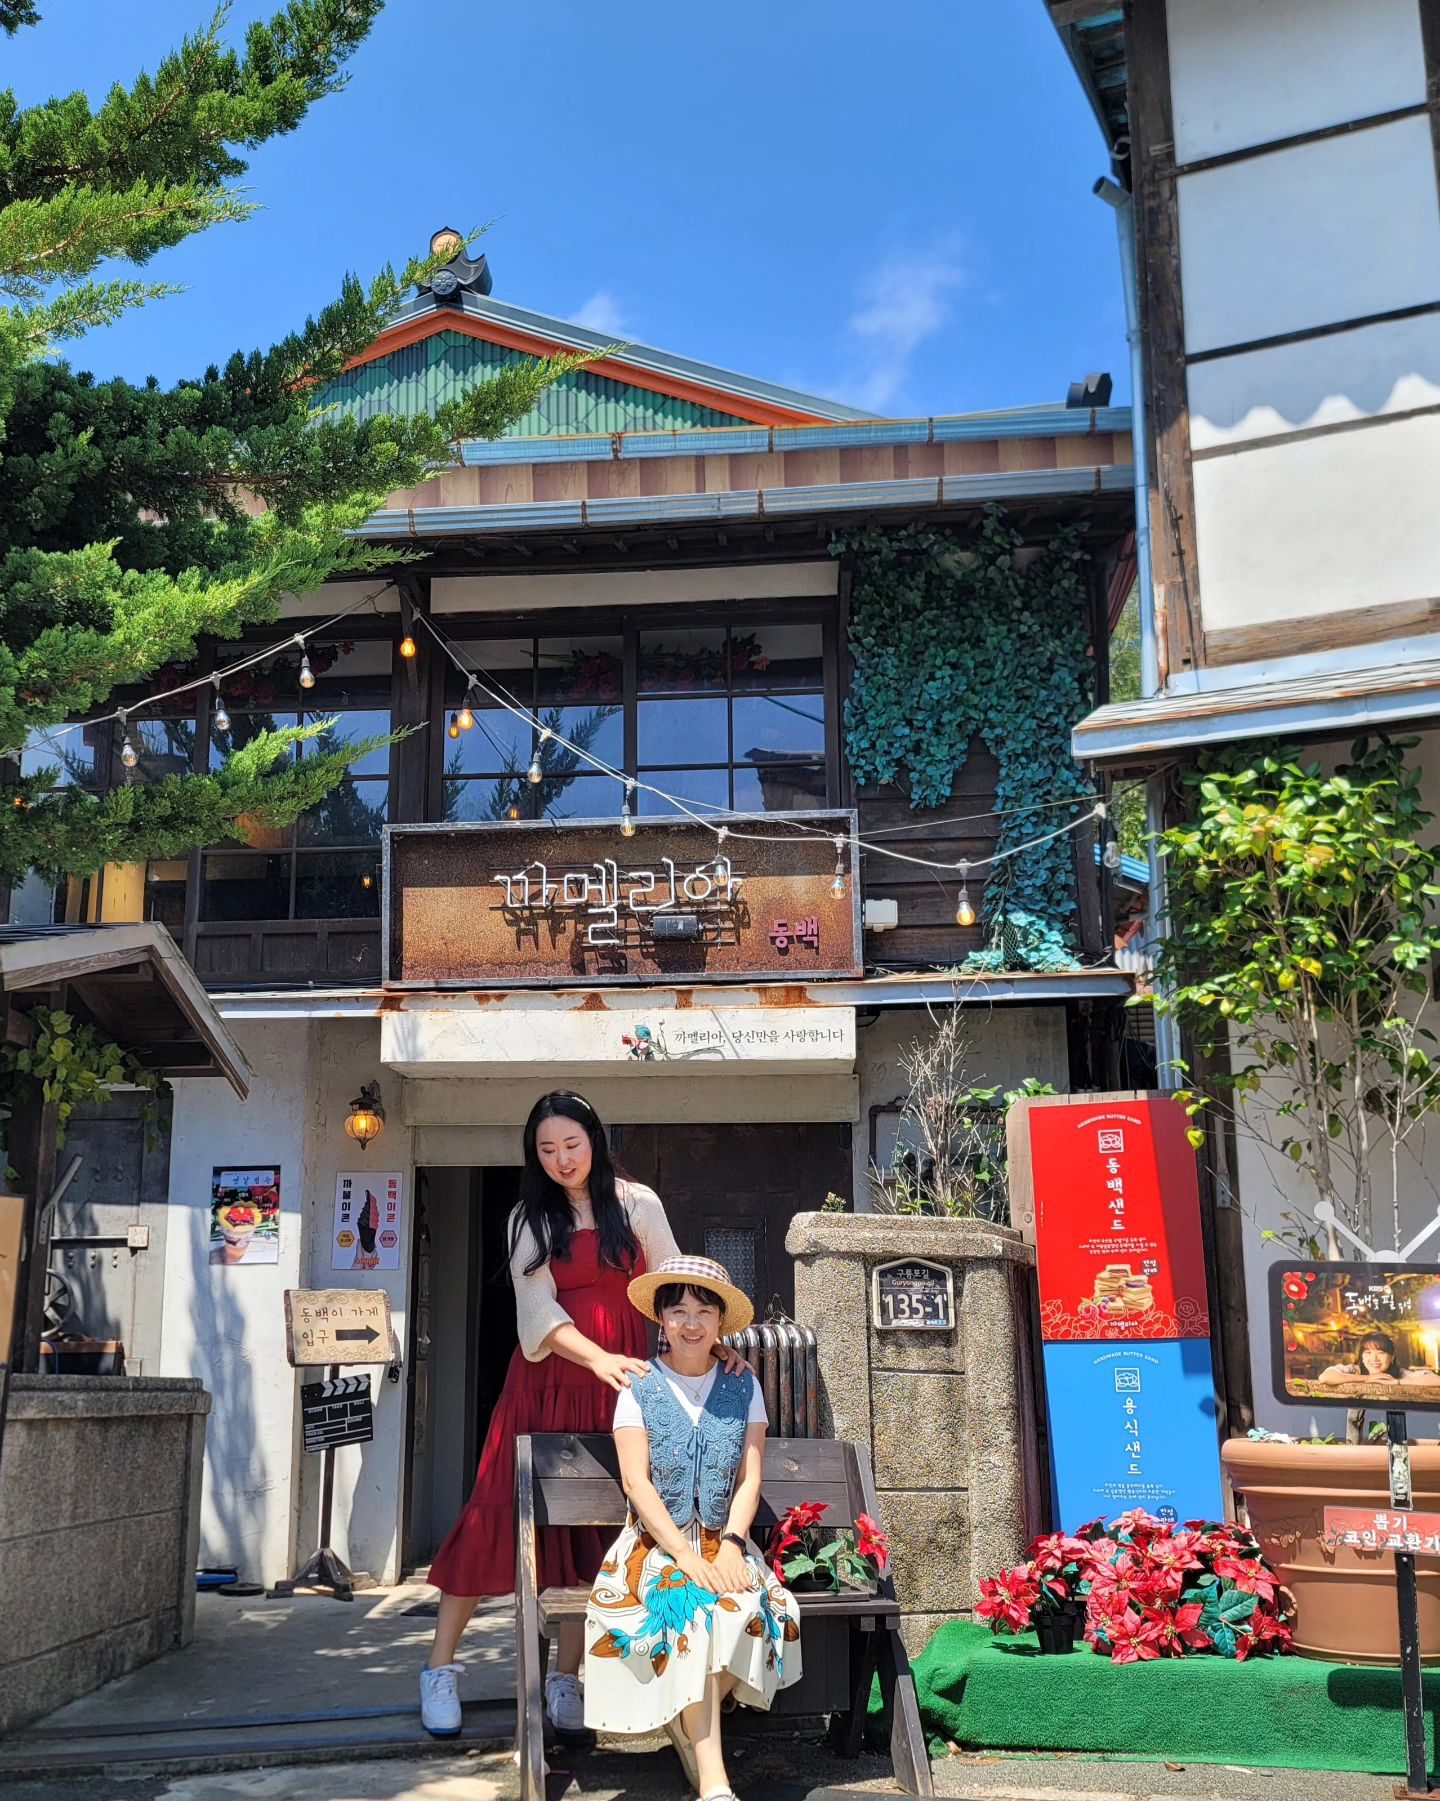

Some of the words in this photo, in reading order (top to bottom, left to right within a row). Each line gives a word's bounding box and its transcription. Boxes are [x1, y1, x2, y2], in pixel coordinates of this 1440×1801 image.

[493, 857, 744, 945] 까멜리아
[768, 915, 819, 948] 동백
[674, 1030, 726, 1045] 까멜리아,
[732, 1030, 780, 1044] 당신만을
[782, 1029, 846, 1044] 사랑합니다
[1106, 1157, 1126, 1230] 동백샌드
[896, 1268, 930, 1280] 구룡포길
[300, 1306, 343, 1323] 동백이
[351, 1306, 379, 1317] 가게
[882, 1293, 944, 1319] 135-1
[302, 1329, 329, 1347] 입구
[1093, 1351, 1122, 1364] HANDMADE
[1122, 1397, 1142, 1475] 용식샌드
[1373, 1513, 1408, 1531] 뽑기
[1343, 1529, 1377, 1547] 코인
[1386, 1532, 1440, 1552] 교환기
